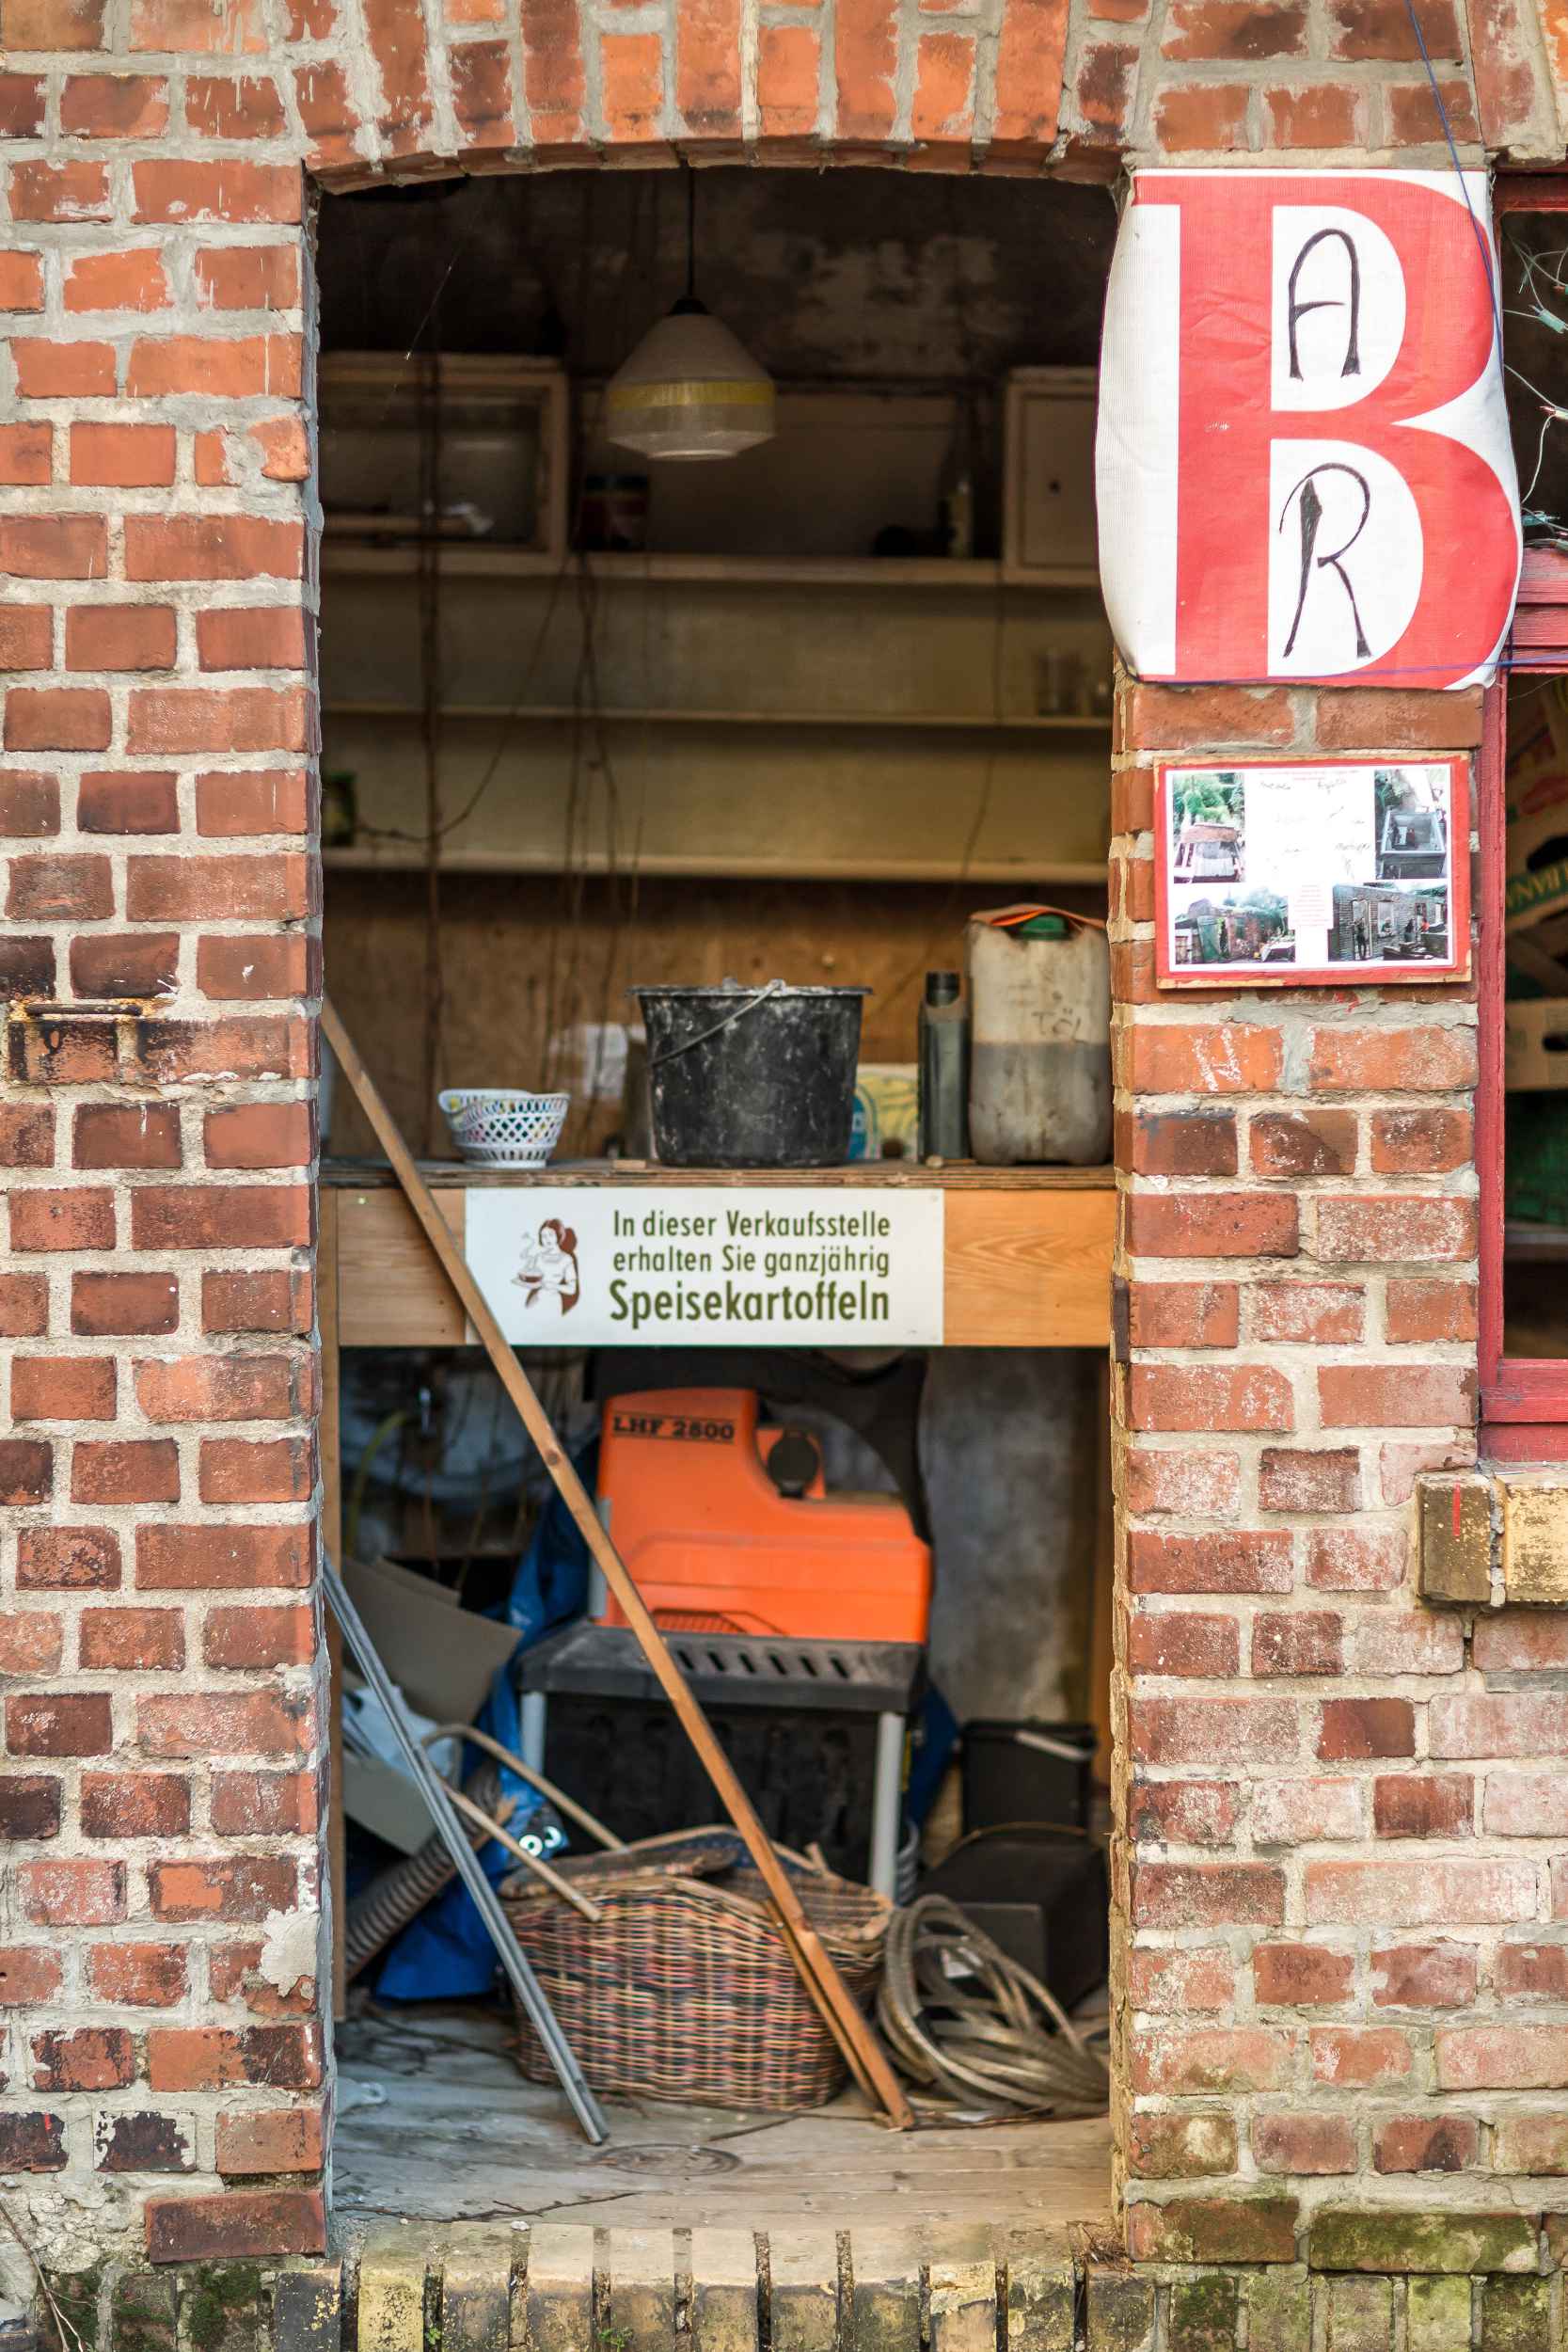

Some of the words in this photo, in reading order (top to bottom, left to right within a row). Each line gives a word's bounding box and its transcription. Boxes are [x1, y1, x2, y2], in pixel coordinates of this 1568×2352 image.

[613, 1209, 636, 1237] In
[642, 1209, 718, 1237] dieser
[726, 1210, 891, 1237] Verkaufsstelle
[612, 1245, 712, 1272] erhalten
[721, 1244, 756, 1272] Sie
[764, 1245, 889, 1278] ganzjährig
[609, 1279, 890, 1329] Speisekartoffeln
[613, 1414, 663, 1436] LHF
